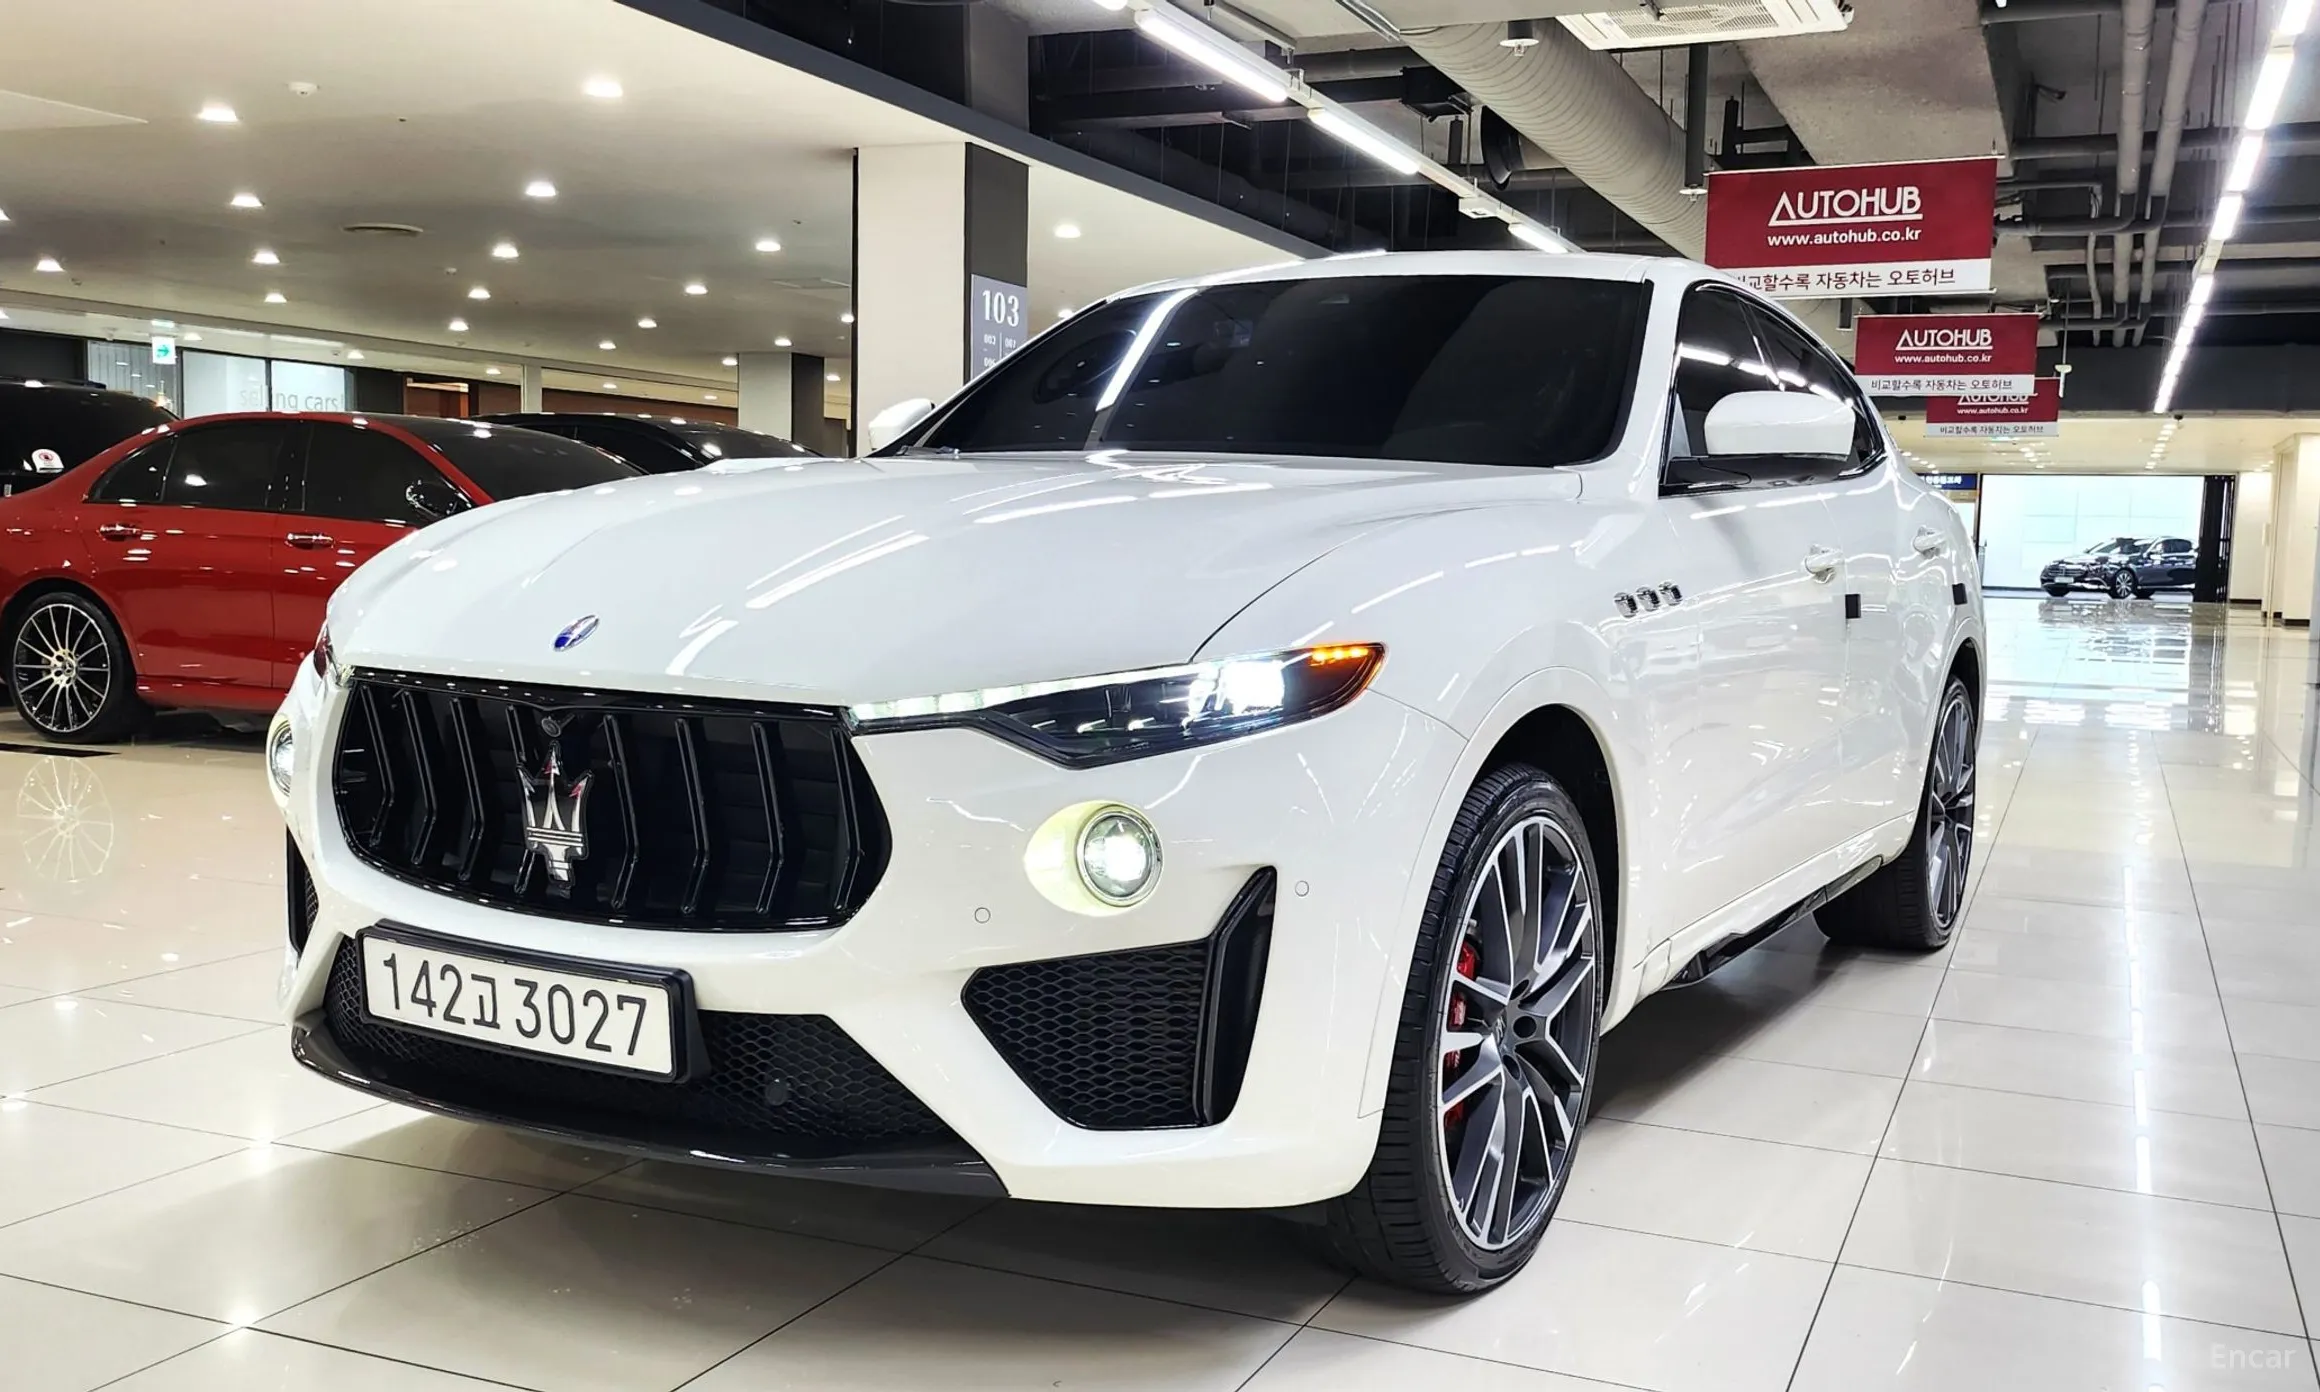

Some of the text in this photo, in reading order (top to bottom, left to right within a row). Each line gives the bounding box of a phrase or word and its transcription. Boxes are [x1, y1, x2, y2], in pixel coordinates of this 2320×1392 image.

[1768, 186, 1923, 227] AUTOHUB
[1767, 227, 1922, 246] www.autohub.co.kr
[1816, 270, 1881, 290] 자동차는
[1887, 267, 1956, 287] 오토허브
[982, 289, 1019, 327] 103
[1895, 328, 1993, 351] AUTOHUB
[1894, 353, 1992, 363] www.autohub.co.kr
[1871, 379, 2012, 391] 비교할수록 자동차는 오토허브
[1957, 406, 2029, 414] www.autohub.co.kr
[383, 952, 647, 1057] 142고 3027
